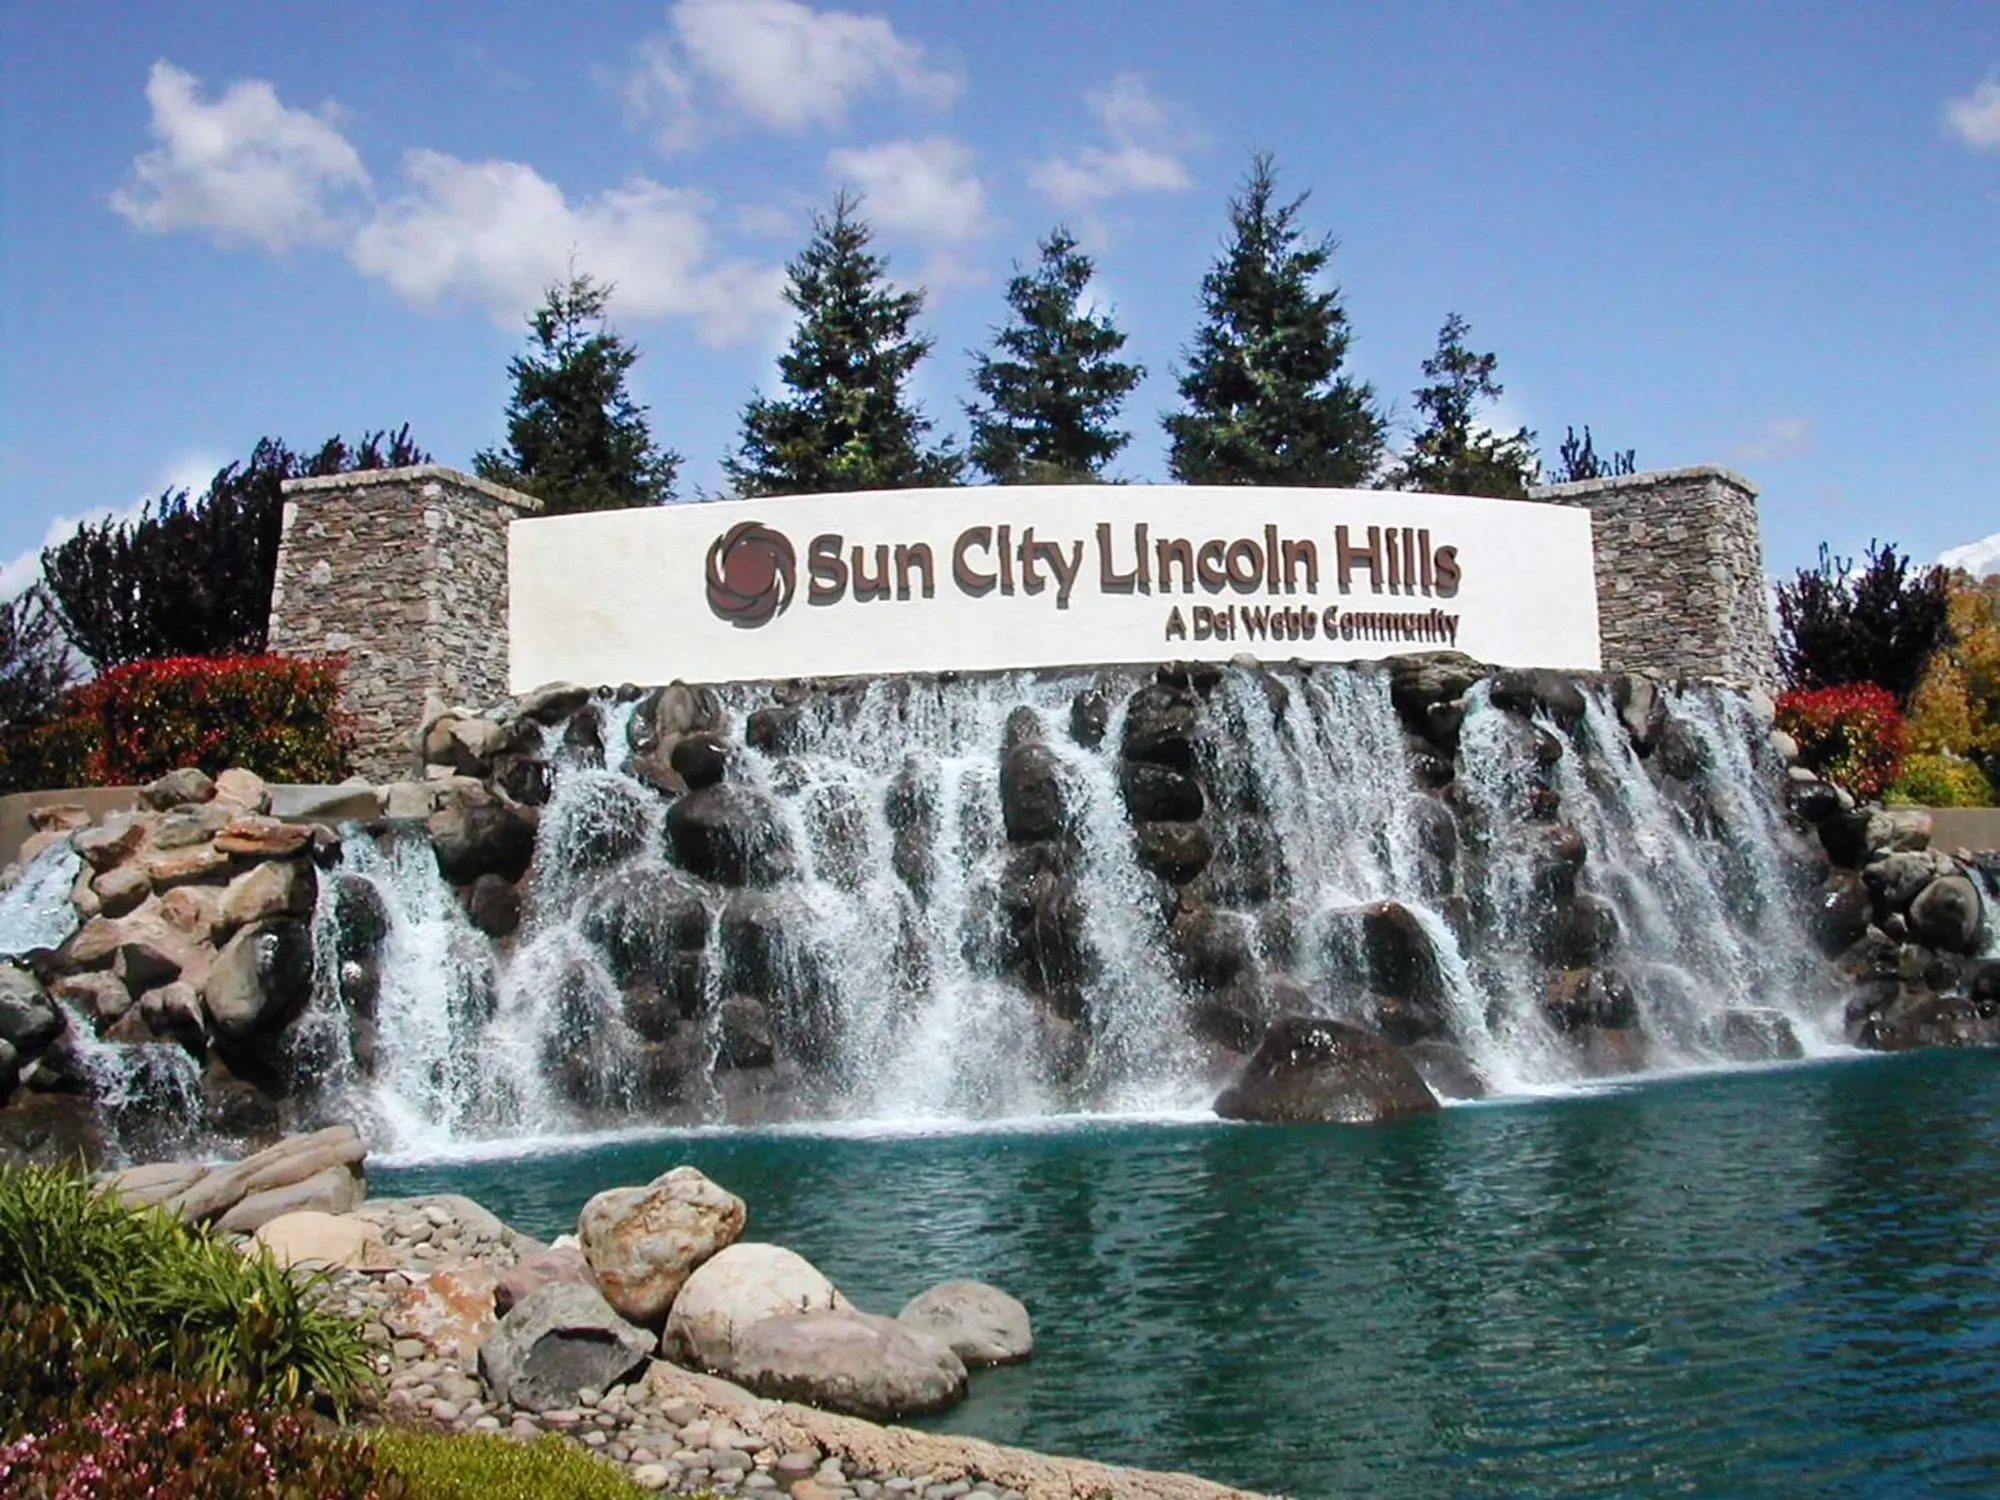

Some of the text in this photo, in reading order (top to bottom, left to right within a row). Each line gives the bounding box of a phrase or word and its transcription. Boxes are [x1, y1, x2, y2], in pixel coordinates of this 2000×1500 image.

[807, 522, 1461, 609] Sun City Lincoln Hills
[1165, 605, 1459, 647] A Del Webb Community
